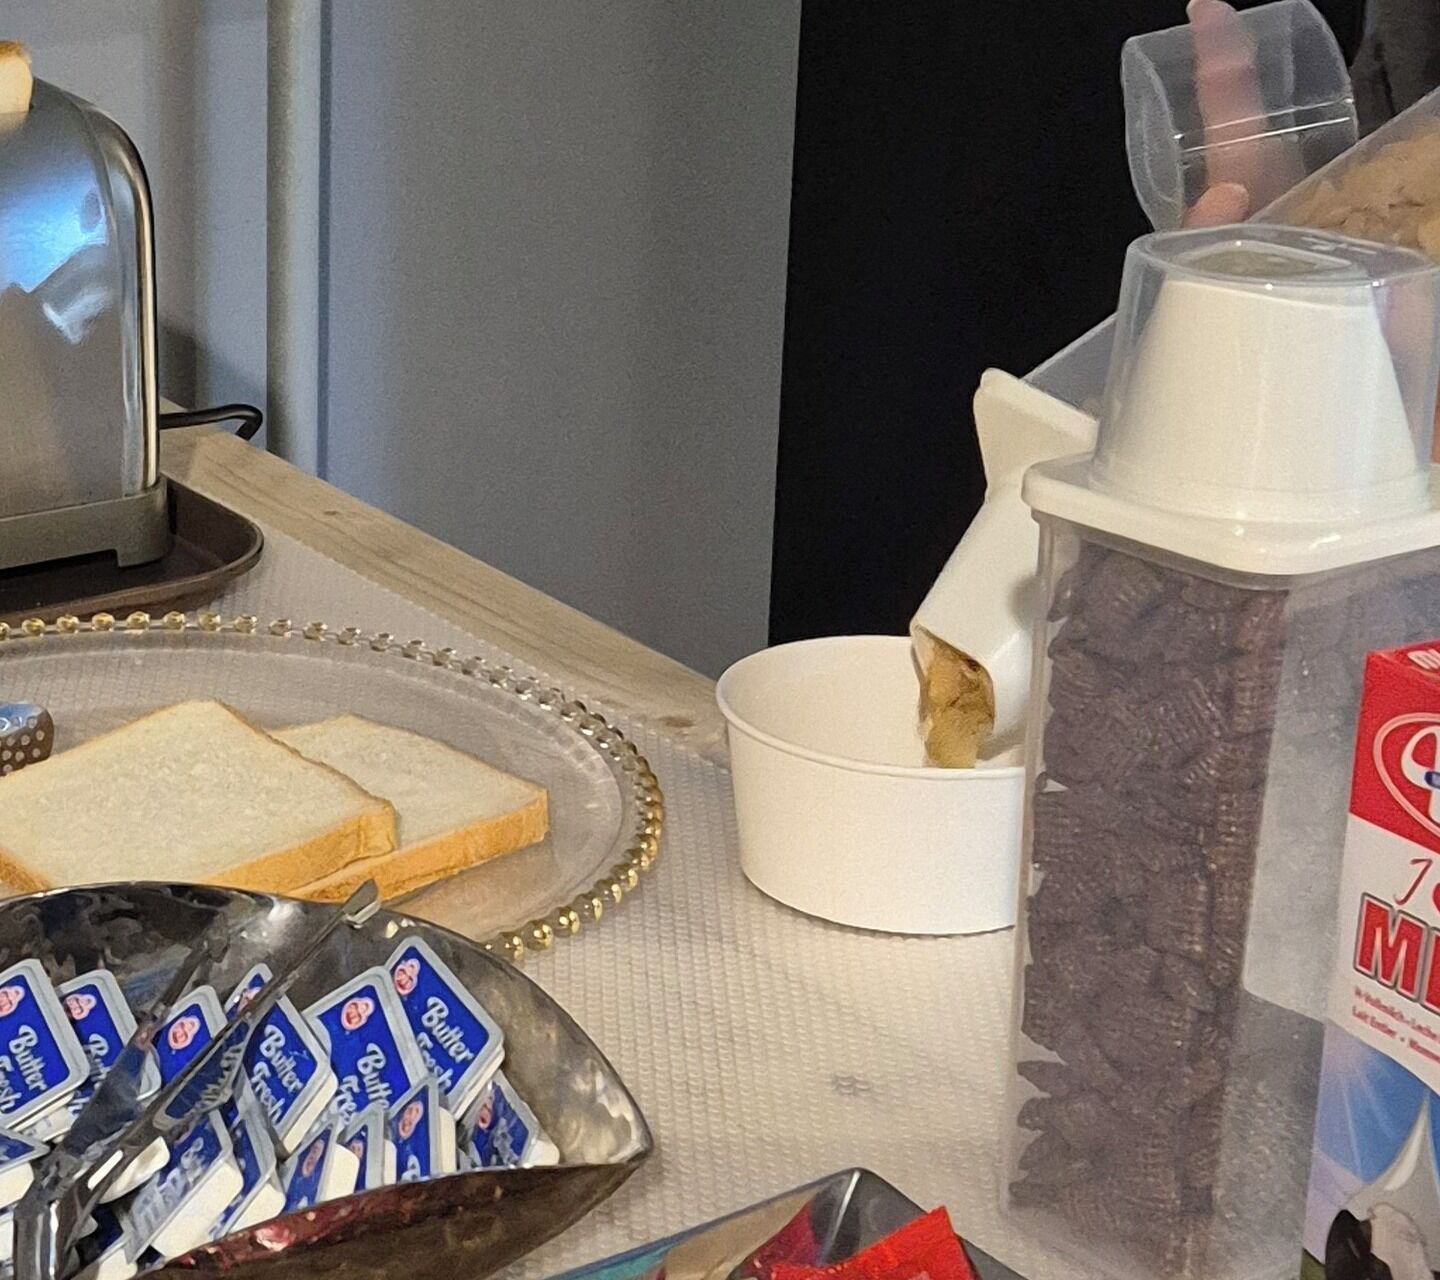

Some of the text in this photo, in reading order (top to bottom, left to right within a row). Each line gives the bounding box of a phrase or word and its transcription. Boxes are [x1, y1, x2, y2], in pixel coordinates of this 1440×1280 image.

[9, 1024, 48, 1091] Butter
[259, 1024, 304, 1093] Butter
[421, 996, 474, 1063] Butter
[251, 1061, 285, 1125] Fresh
